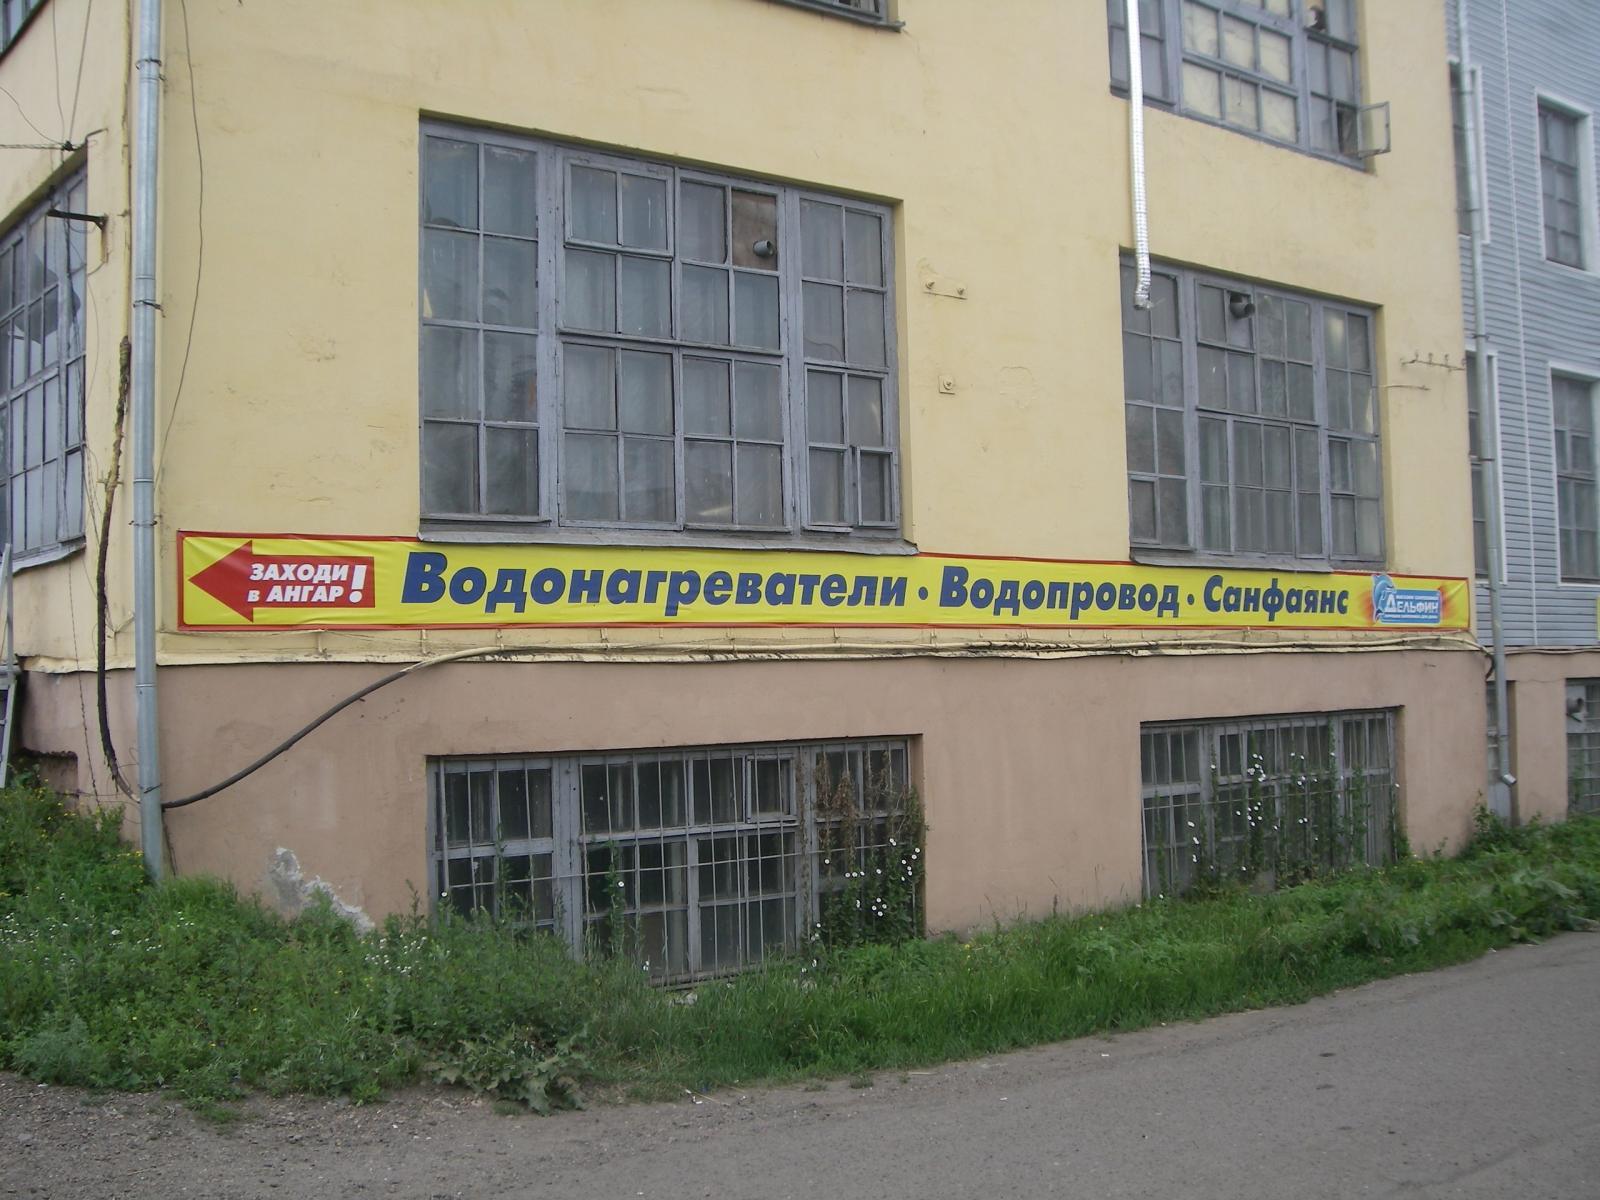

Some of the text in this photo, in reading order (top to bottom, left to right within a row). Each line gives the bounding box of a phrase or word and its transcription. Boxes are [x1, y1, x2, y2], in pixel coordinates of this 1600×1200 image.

[247, 589, 260, 603] в
[249, 563, 349, 584] ЗАХОДИ
[401, 552, 908, 617] Водонагреватели
[940, 565, 1178, 619] Водопровод
[1204, 574, 1350, 621] Санфаянс
